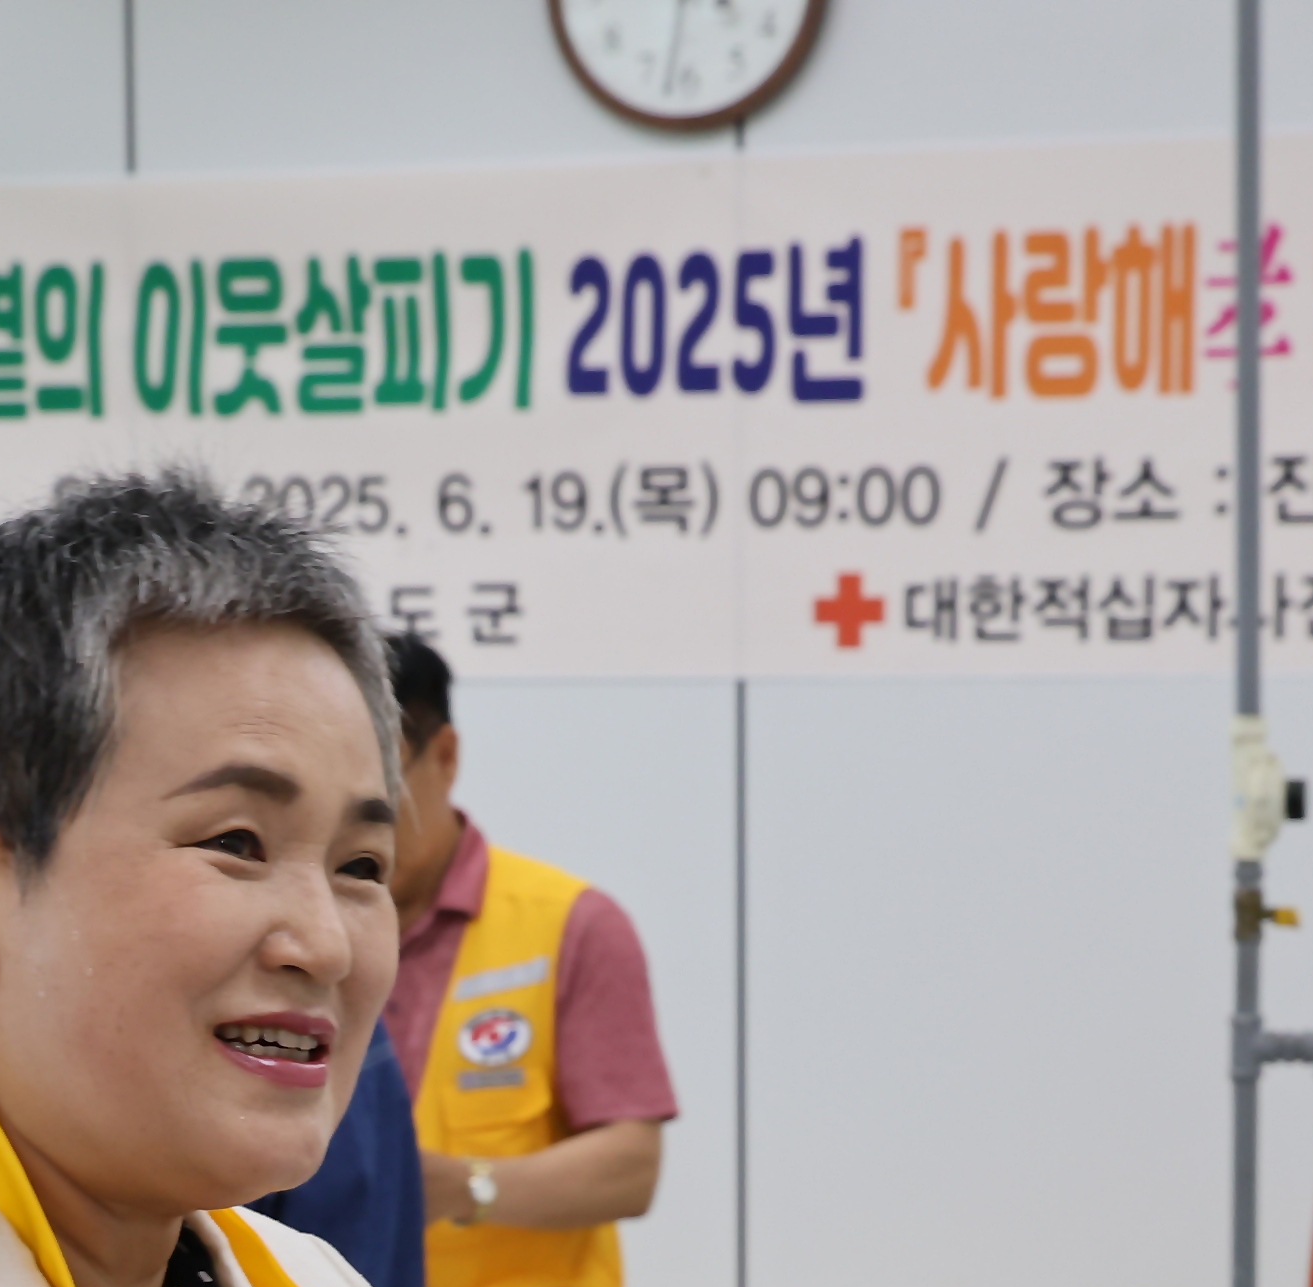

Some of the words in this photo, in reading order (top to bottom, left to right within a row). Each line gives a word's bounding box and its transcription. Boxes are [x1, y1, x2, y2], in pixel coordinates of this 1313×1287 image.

[133, 246, 535, 417] 이웃살피기
[566, 236, 863, 402] 2025년
[438, 473, 491, 536] 6.
[525, 462, 719, 538] 19.(목)
[748, 464, 942, 529] 09:00
[976, 458, 1008, 532] /
[1044, 458, 1181, 531] 장소
